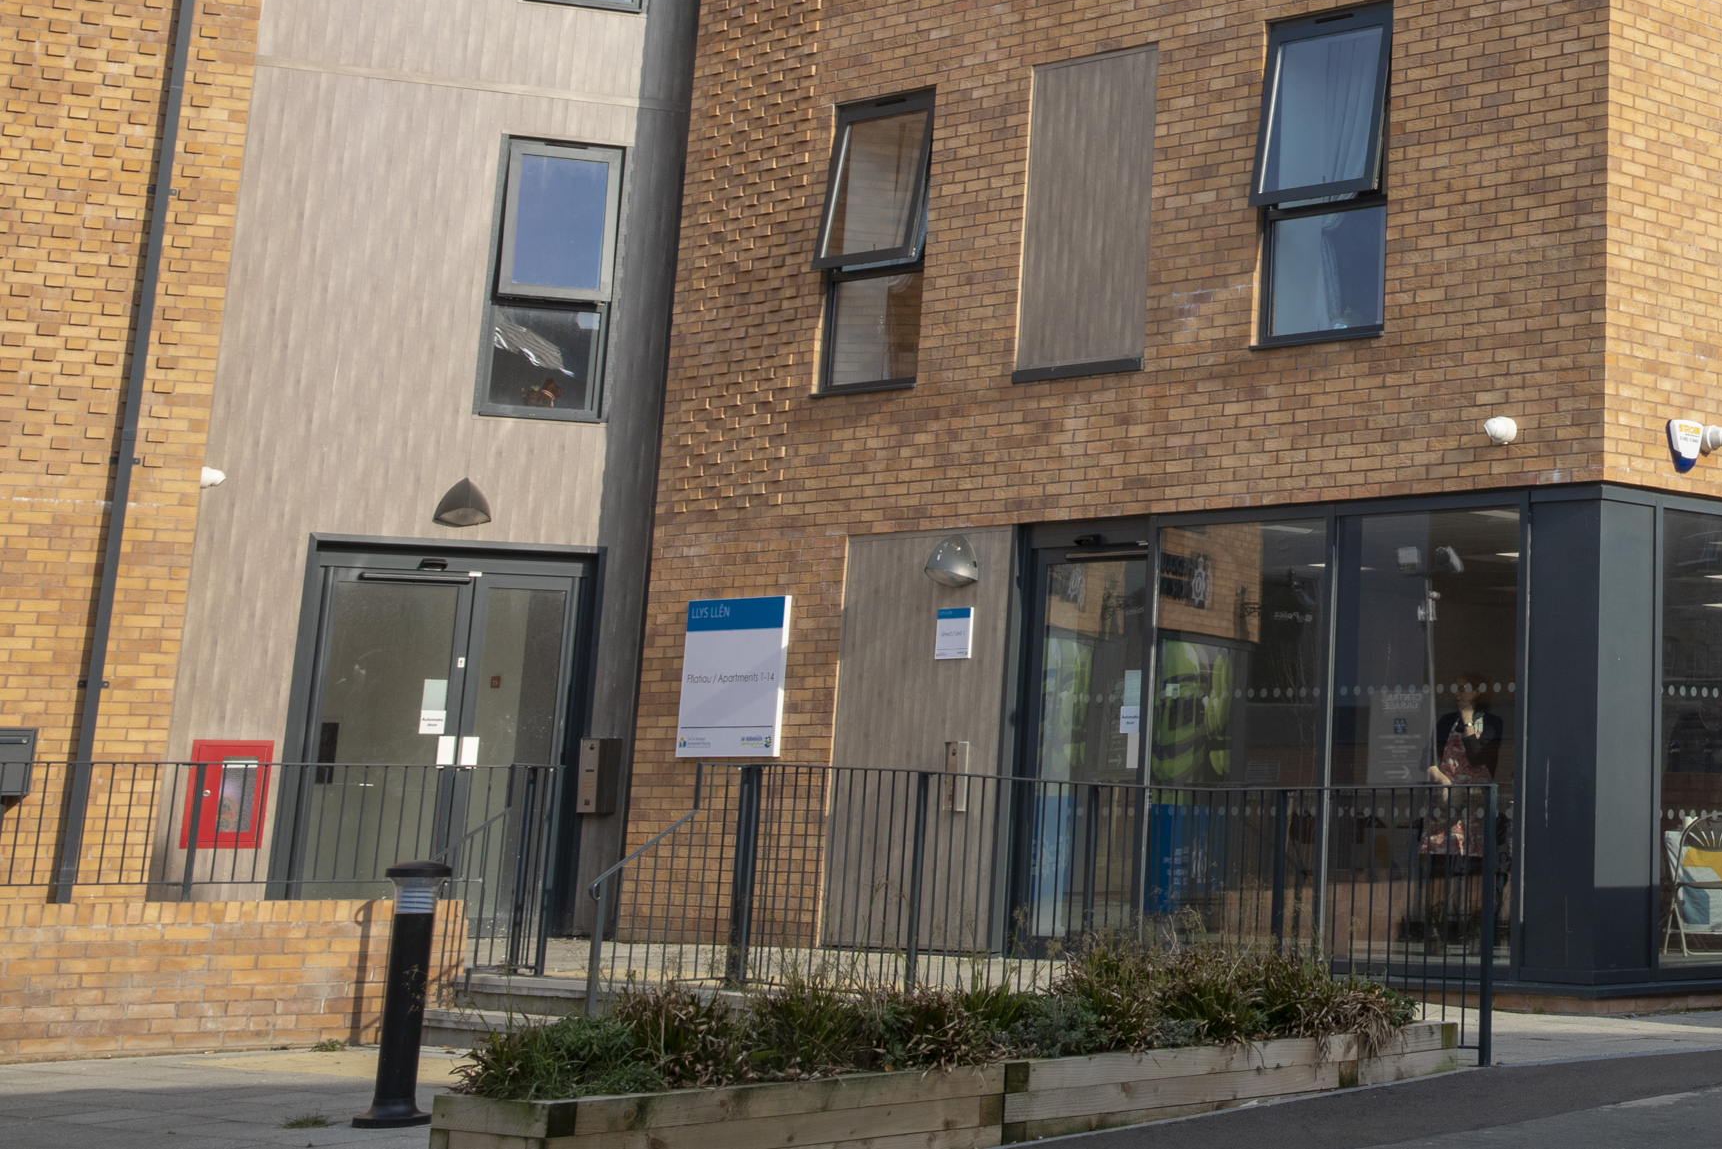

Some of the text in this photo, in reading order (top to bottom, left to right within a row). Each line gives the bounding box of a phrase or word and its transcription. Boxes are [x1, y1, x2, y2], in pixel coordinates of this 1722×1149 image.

[691, 604, 730, 619] LLYS LLÊN
[686, 673, 712, 684] Fflatiau
[718, 672, 759, 684] Apartments
[760, 672, 775, 682] 1-14
